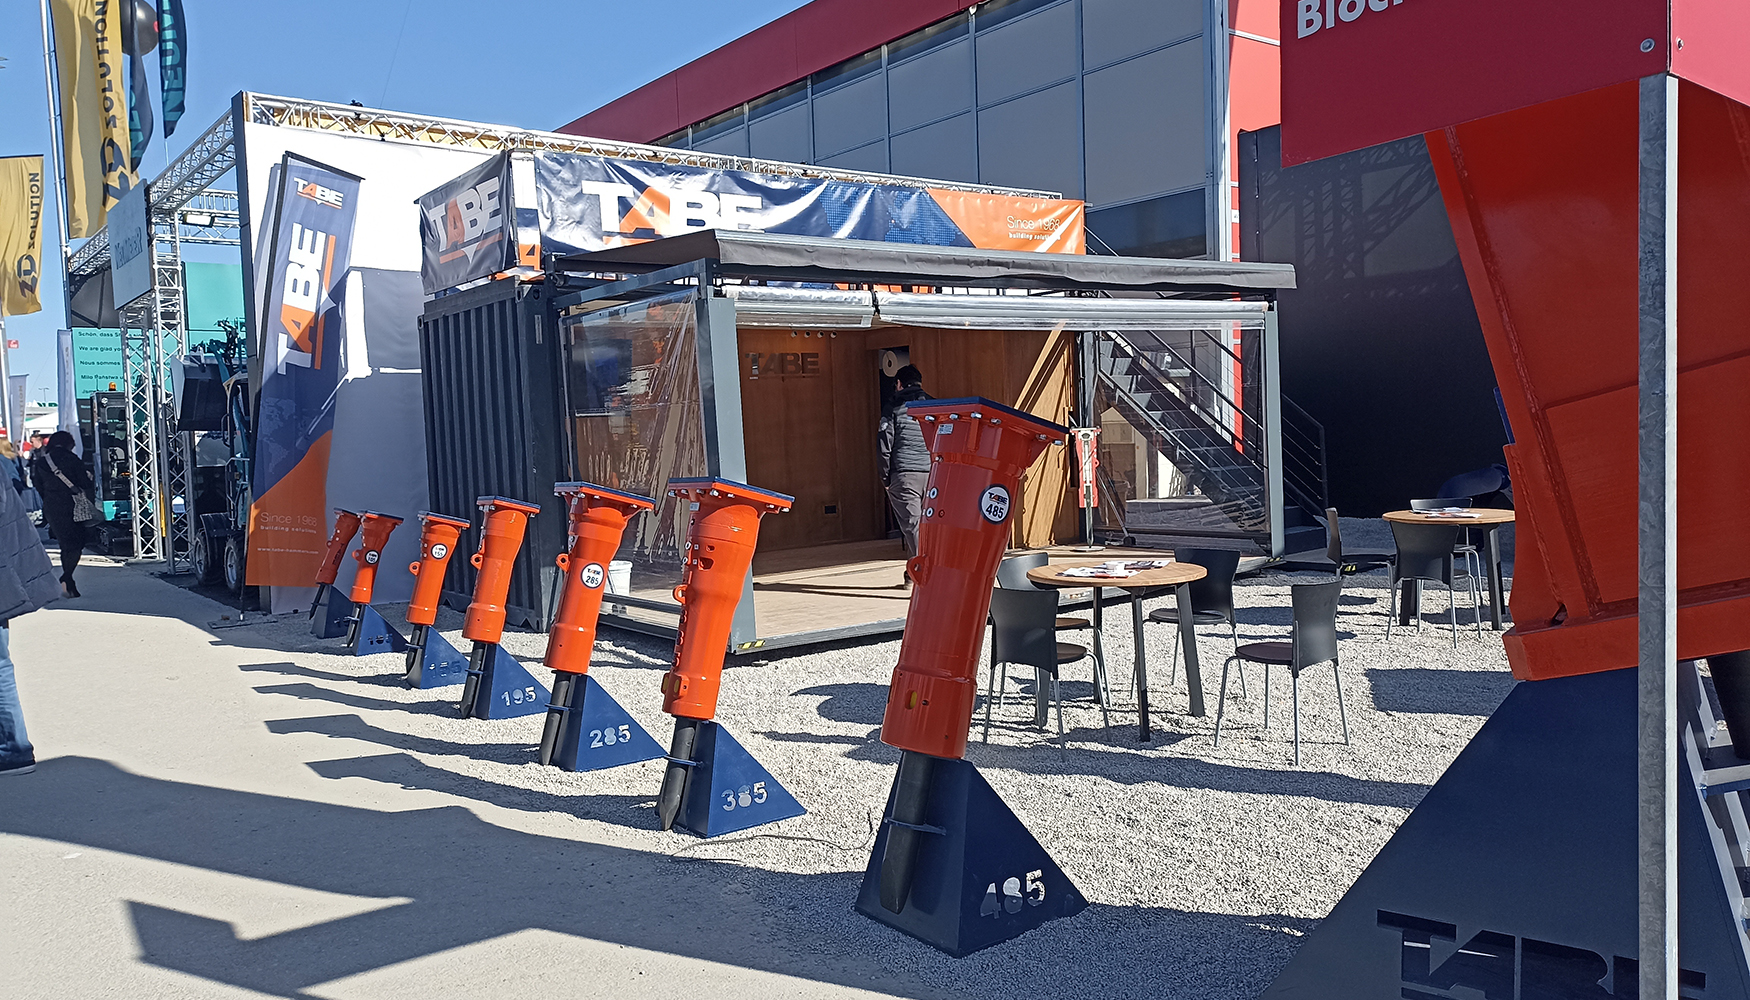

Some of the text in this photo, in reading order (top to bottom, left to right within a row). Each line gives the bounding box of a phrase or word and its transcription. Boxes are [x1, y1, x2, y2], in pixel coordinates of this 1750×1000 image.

[1297, 0, 1404, 39] Blo
[94, 1, 118, 129] SOLUTION
[293, 177, 344, 206] TABE
[28, 172, 40, 250] SOLUTION
[429, 176, 503, 252] TABE
[581, 180, 765, 235] TABE
[1006, 215, 1061, 231] Since 1968
[1008, 231, 1033, 240] building
[277, 222, 327, 376] TABE
[745, 352, 820, 375] TABE
[985, 503, 1005, 519] 485
[988, 491, 1008, 504] TABE
[260, 511, 292, 524] Since
[585, 575, 599, 585] 285
[501, 686, 537, 707] 195
[589, 724, 632, 749] 285
[720, 781, 768, 812] 385
[979, 869, 1047, 920] 485
